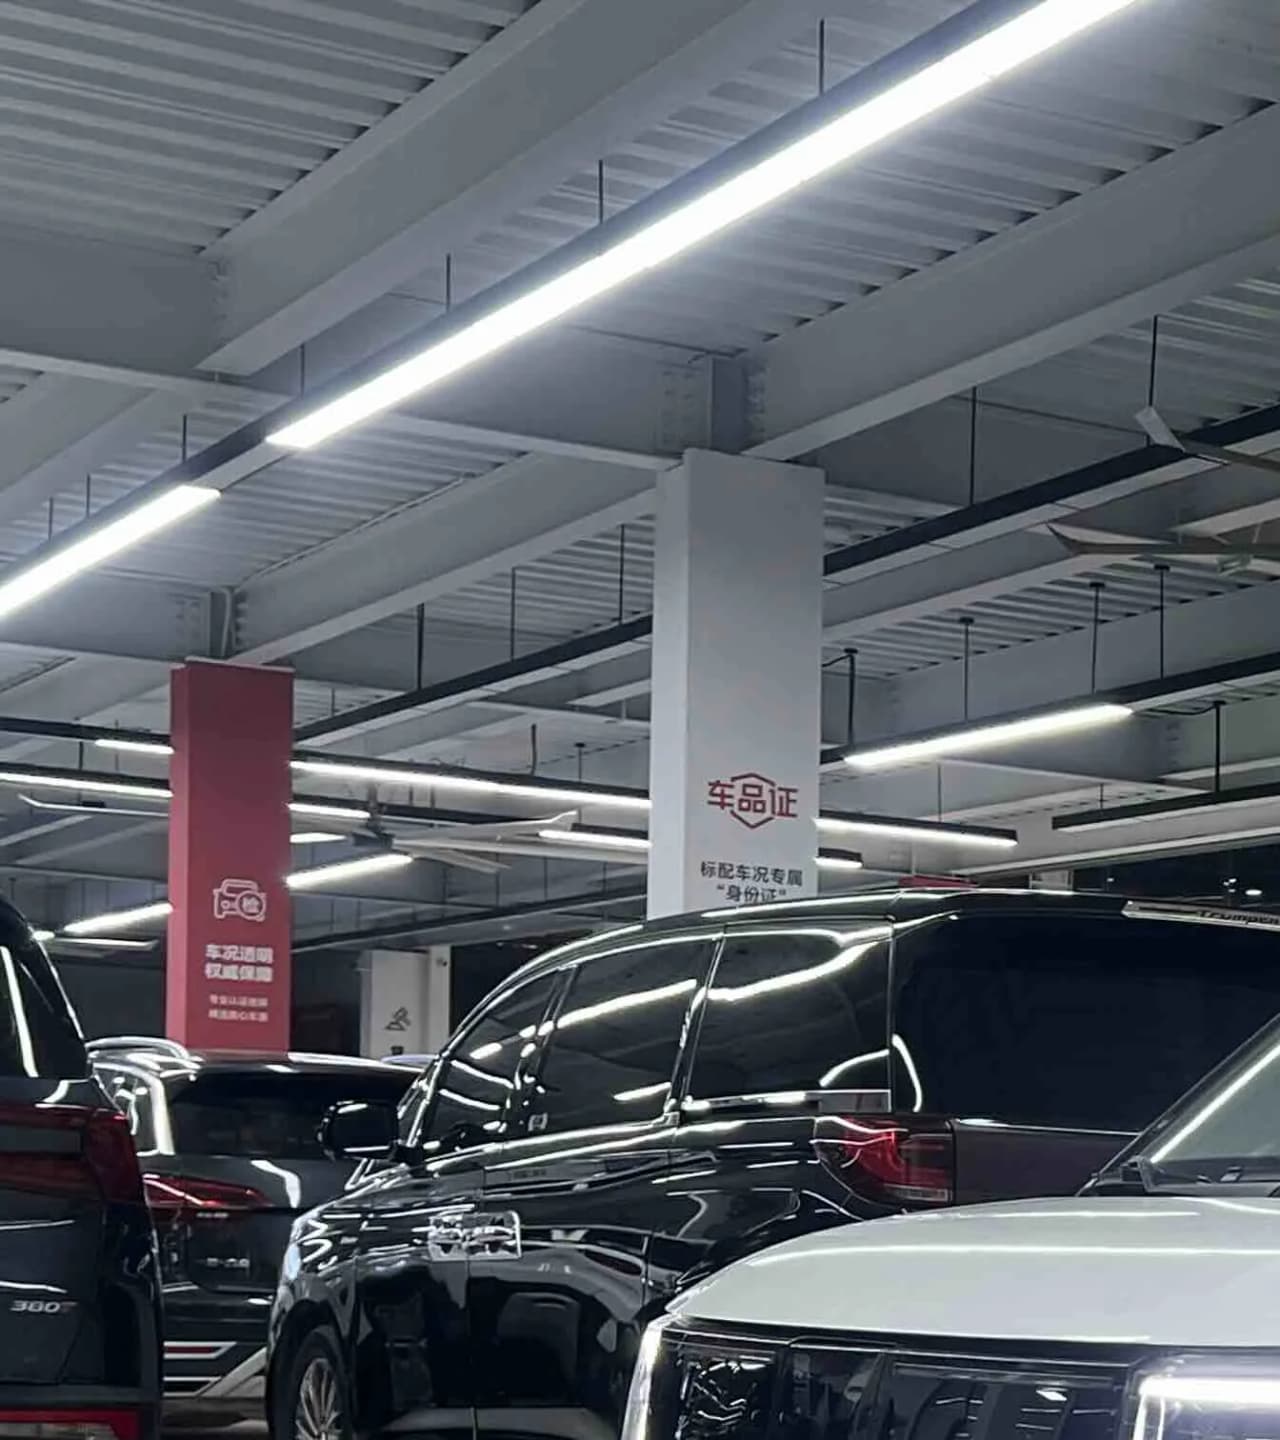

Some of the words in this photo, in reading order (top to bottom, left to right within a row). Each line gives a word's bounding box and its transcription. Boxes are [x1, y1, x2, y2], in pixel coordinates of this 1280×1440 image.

[706, 779, 799, 818] 车品证
[700, 860, 803, 887] 标配车况专属
